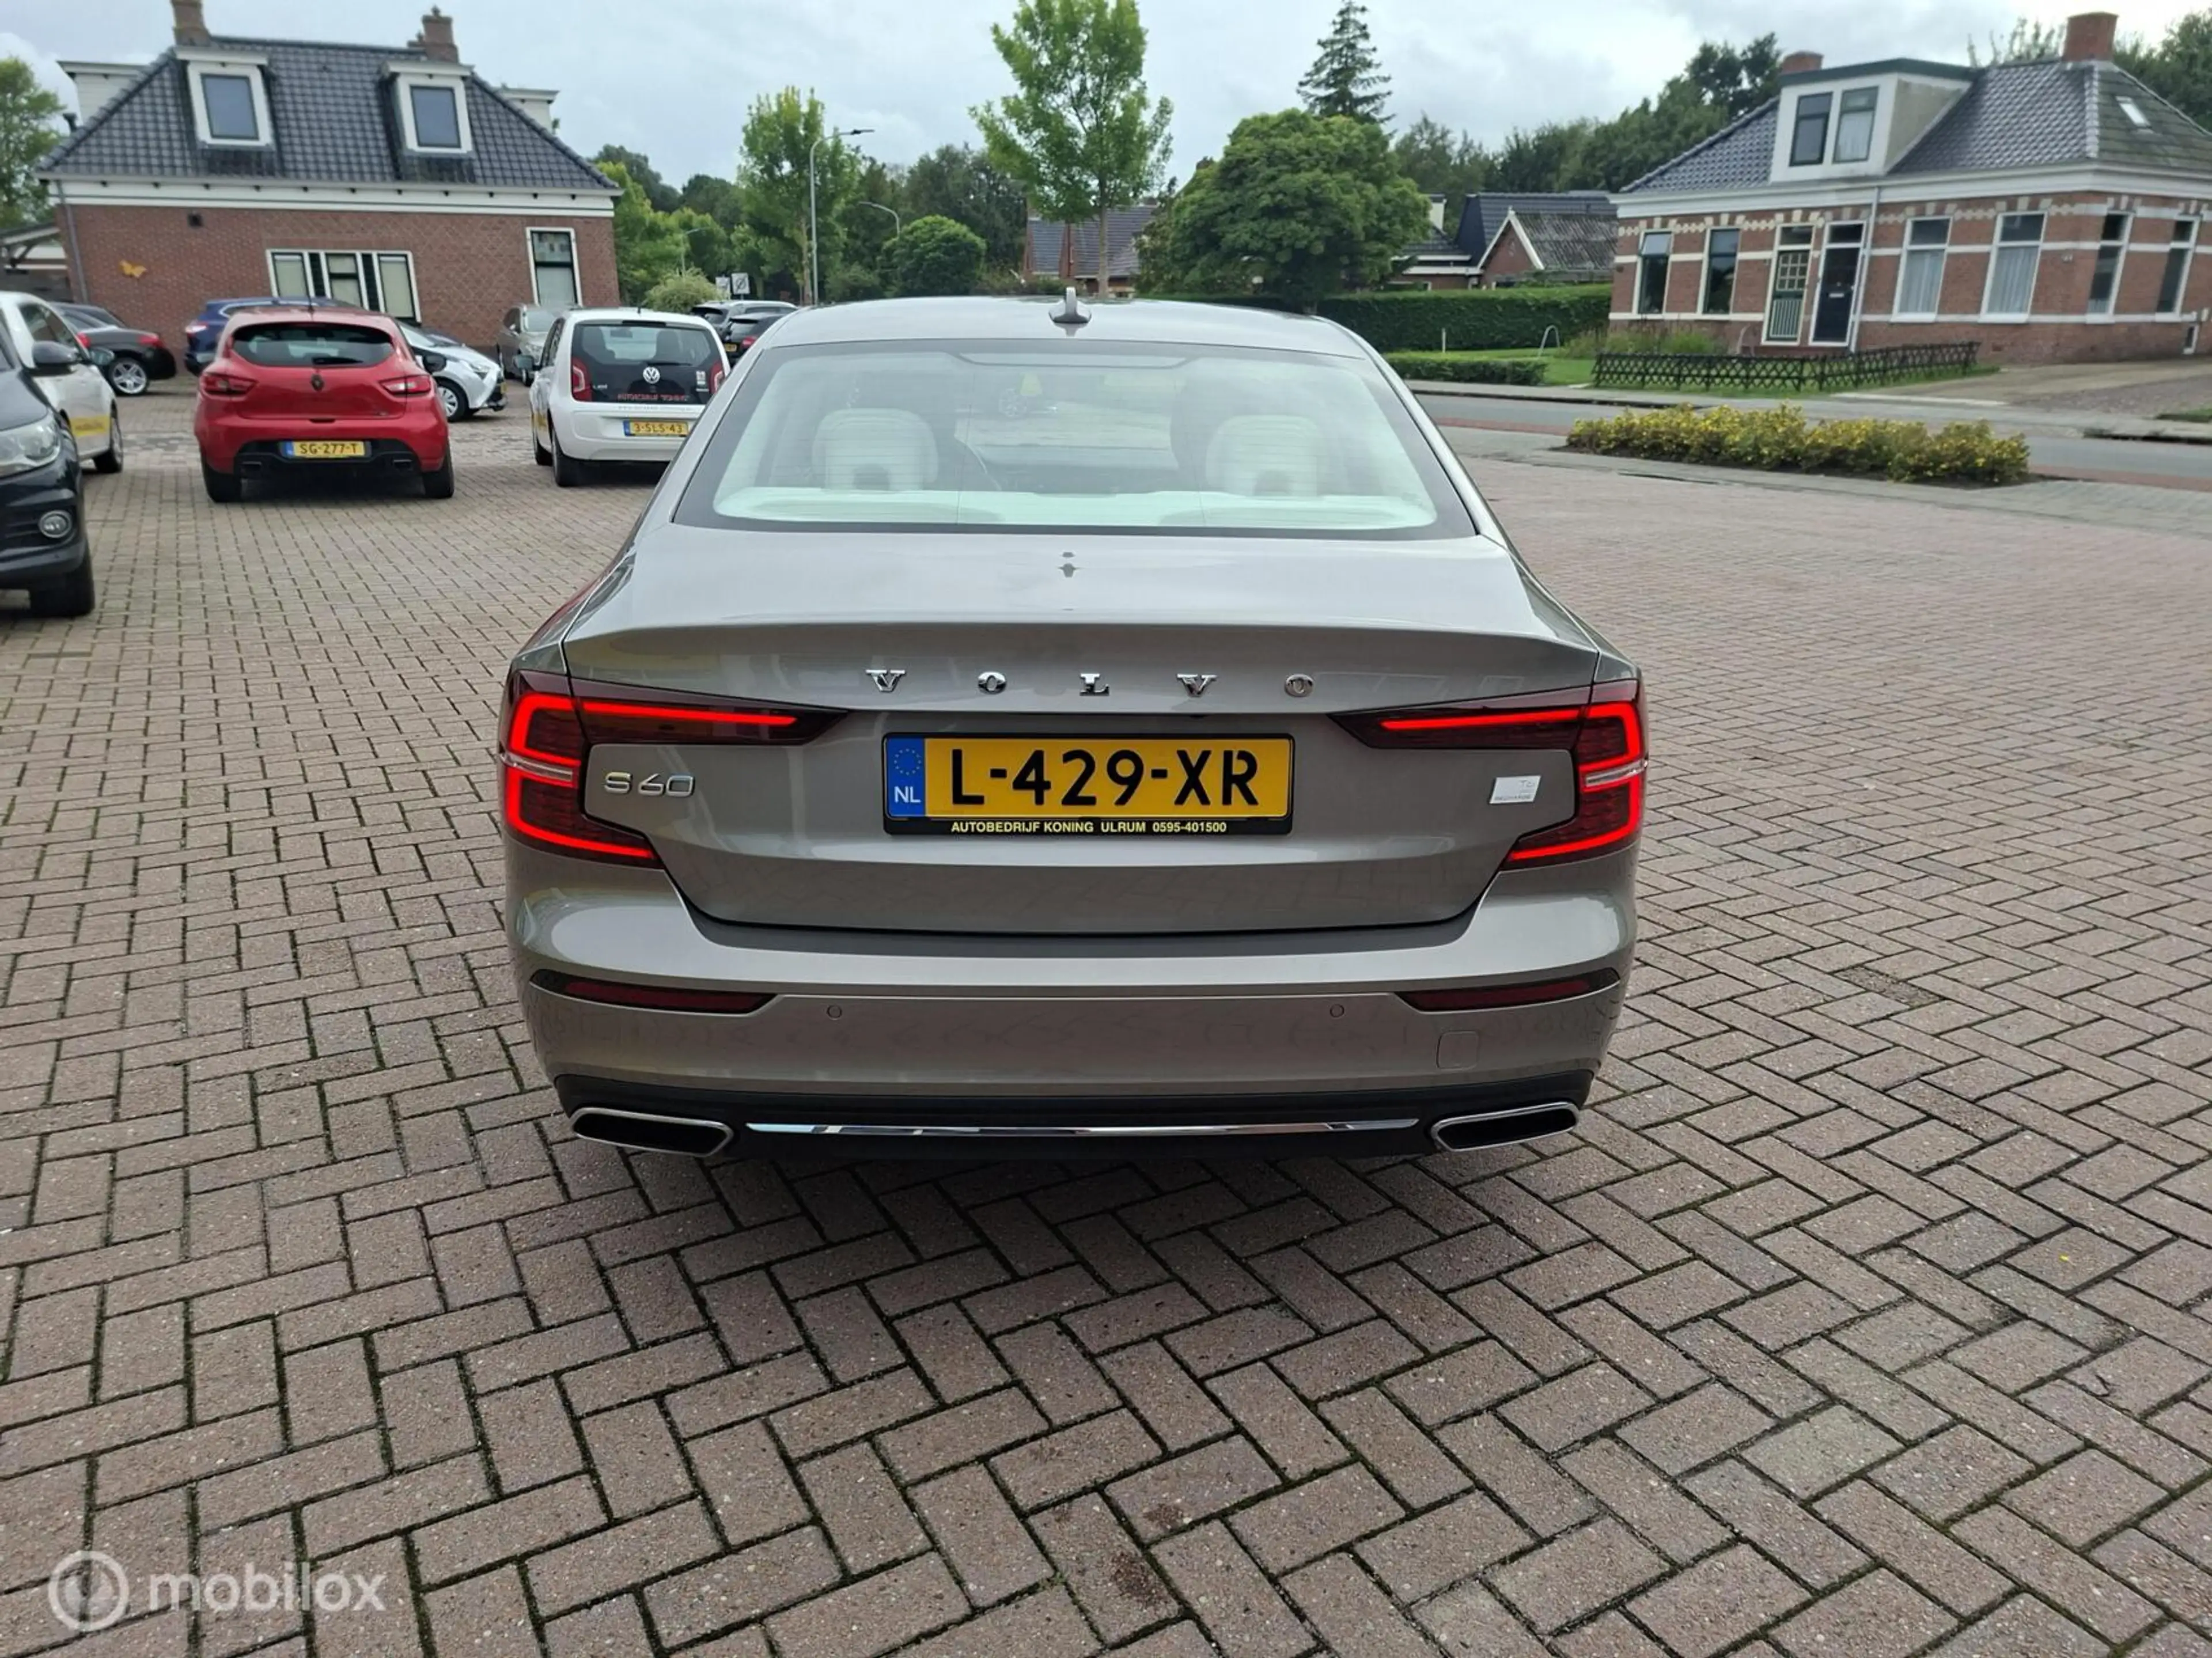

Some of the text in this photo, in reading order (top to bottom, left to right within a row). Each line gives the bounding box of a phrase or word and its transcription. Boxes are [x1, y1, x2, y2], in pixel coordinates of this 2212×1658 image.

[299, 443, 359, 454] SG-277-T
[866, 669, 1315, 697] VOLVO
[952, 749, 1259, 806] L-429-XR
[894, 786, 921, 803] NL
[950, 821, 1227, 833] AUTOBEDRIJF KONING ULRUM 0595-401500
